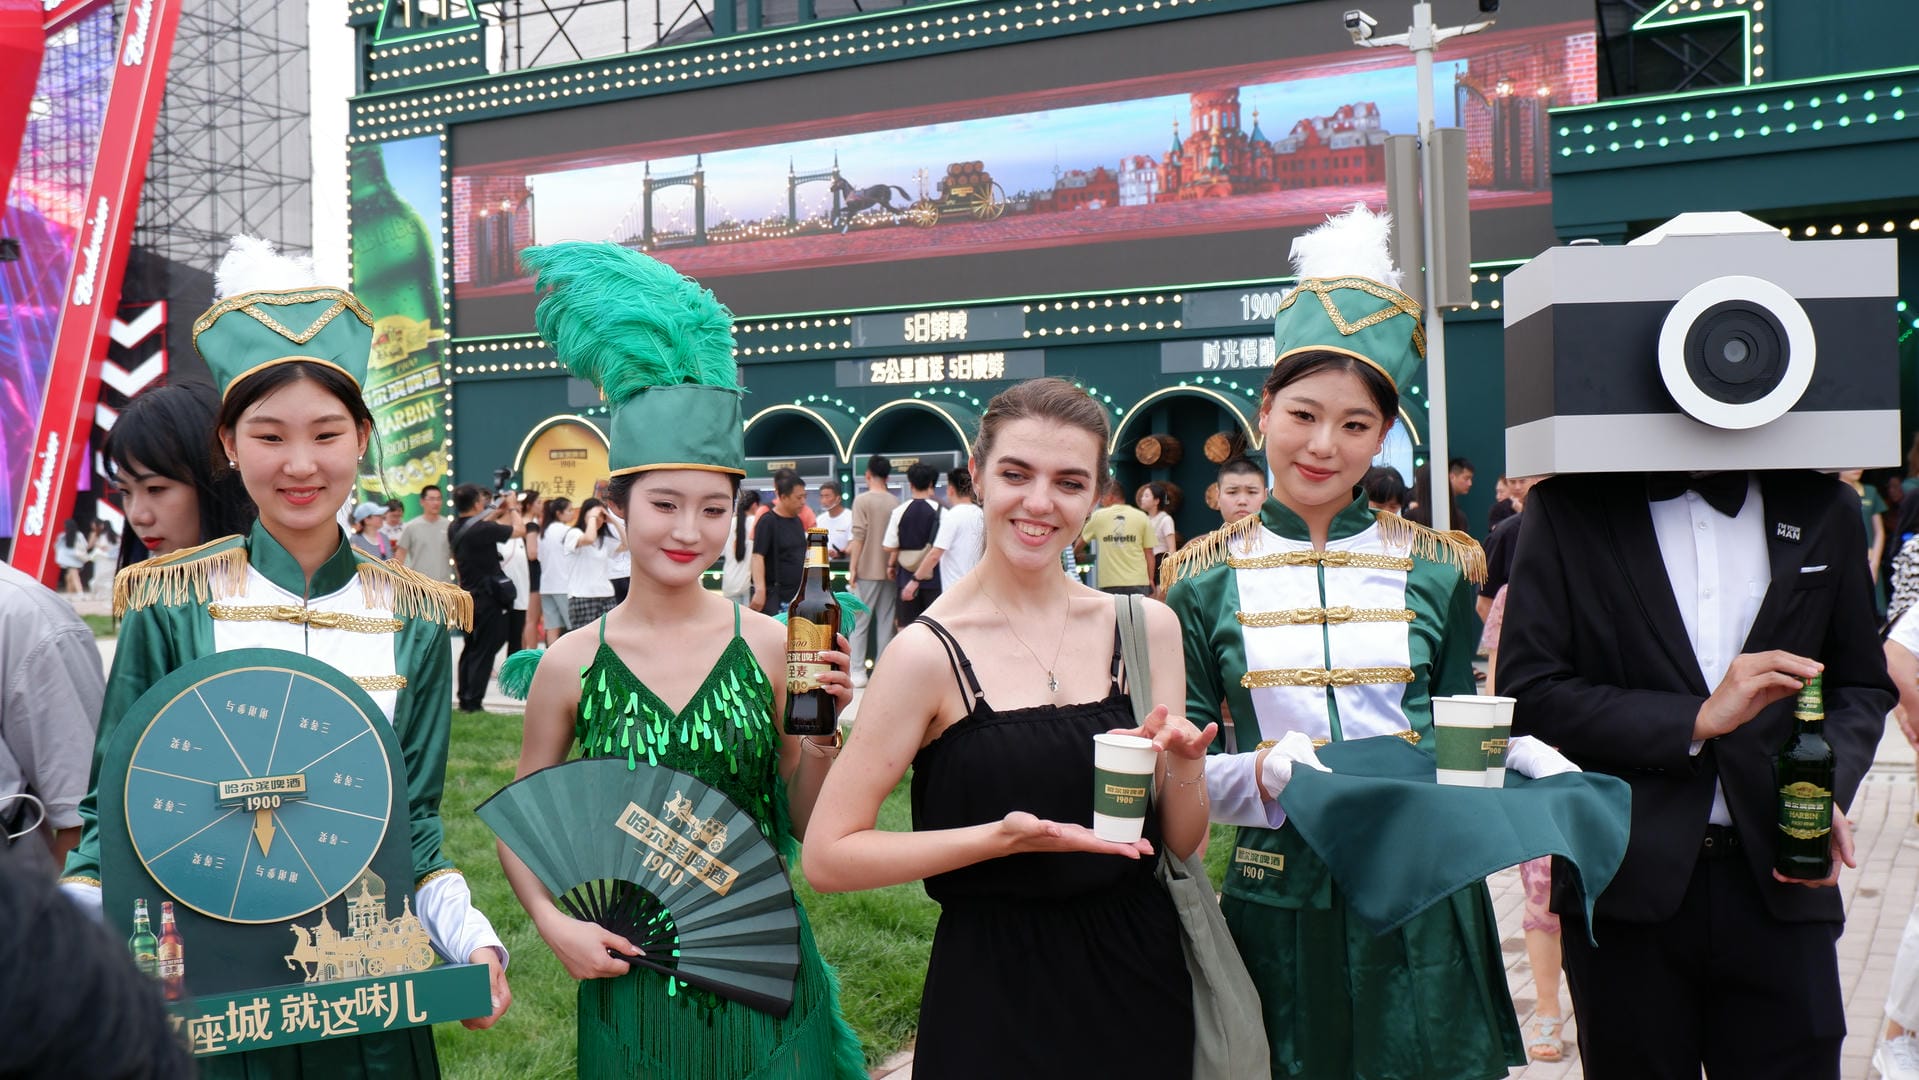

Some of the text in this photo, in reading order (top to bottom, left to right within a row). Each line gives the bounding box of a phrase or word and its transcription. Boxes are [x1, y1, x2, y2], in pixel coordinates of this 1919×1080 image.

[1240, 287, 1296, 320] 1900
[1777, 528, 1800, 541] MAN
[224, 777, 301, 795] 哈尔滨啤酒
[247, 794, 281, 811] 1900
[625, 809, 730, 886] 哈尔滨啤酒
[642, 850, 685, 887] 1900
[167, 980, 428, 1055] 座城 就这味儿
